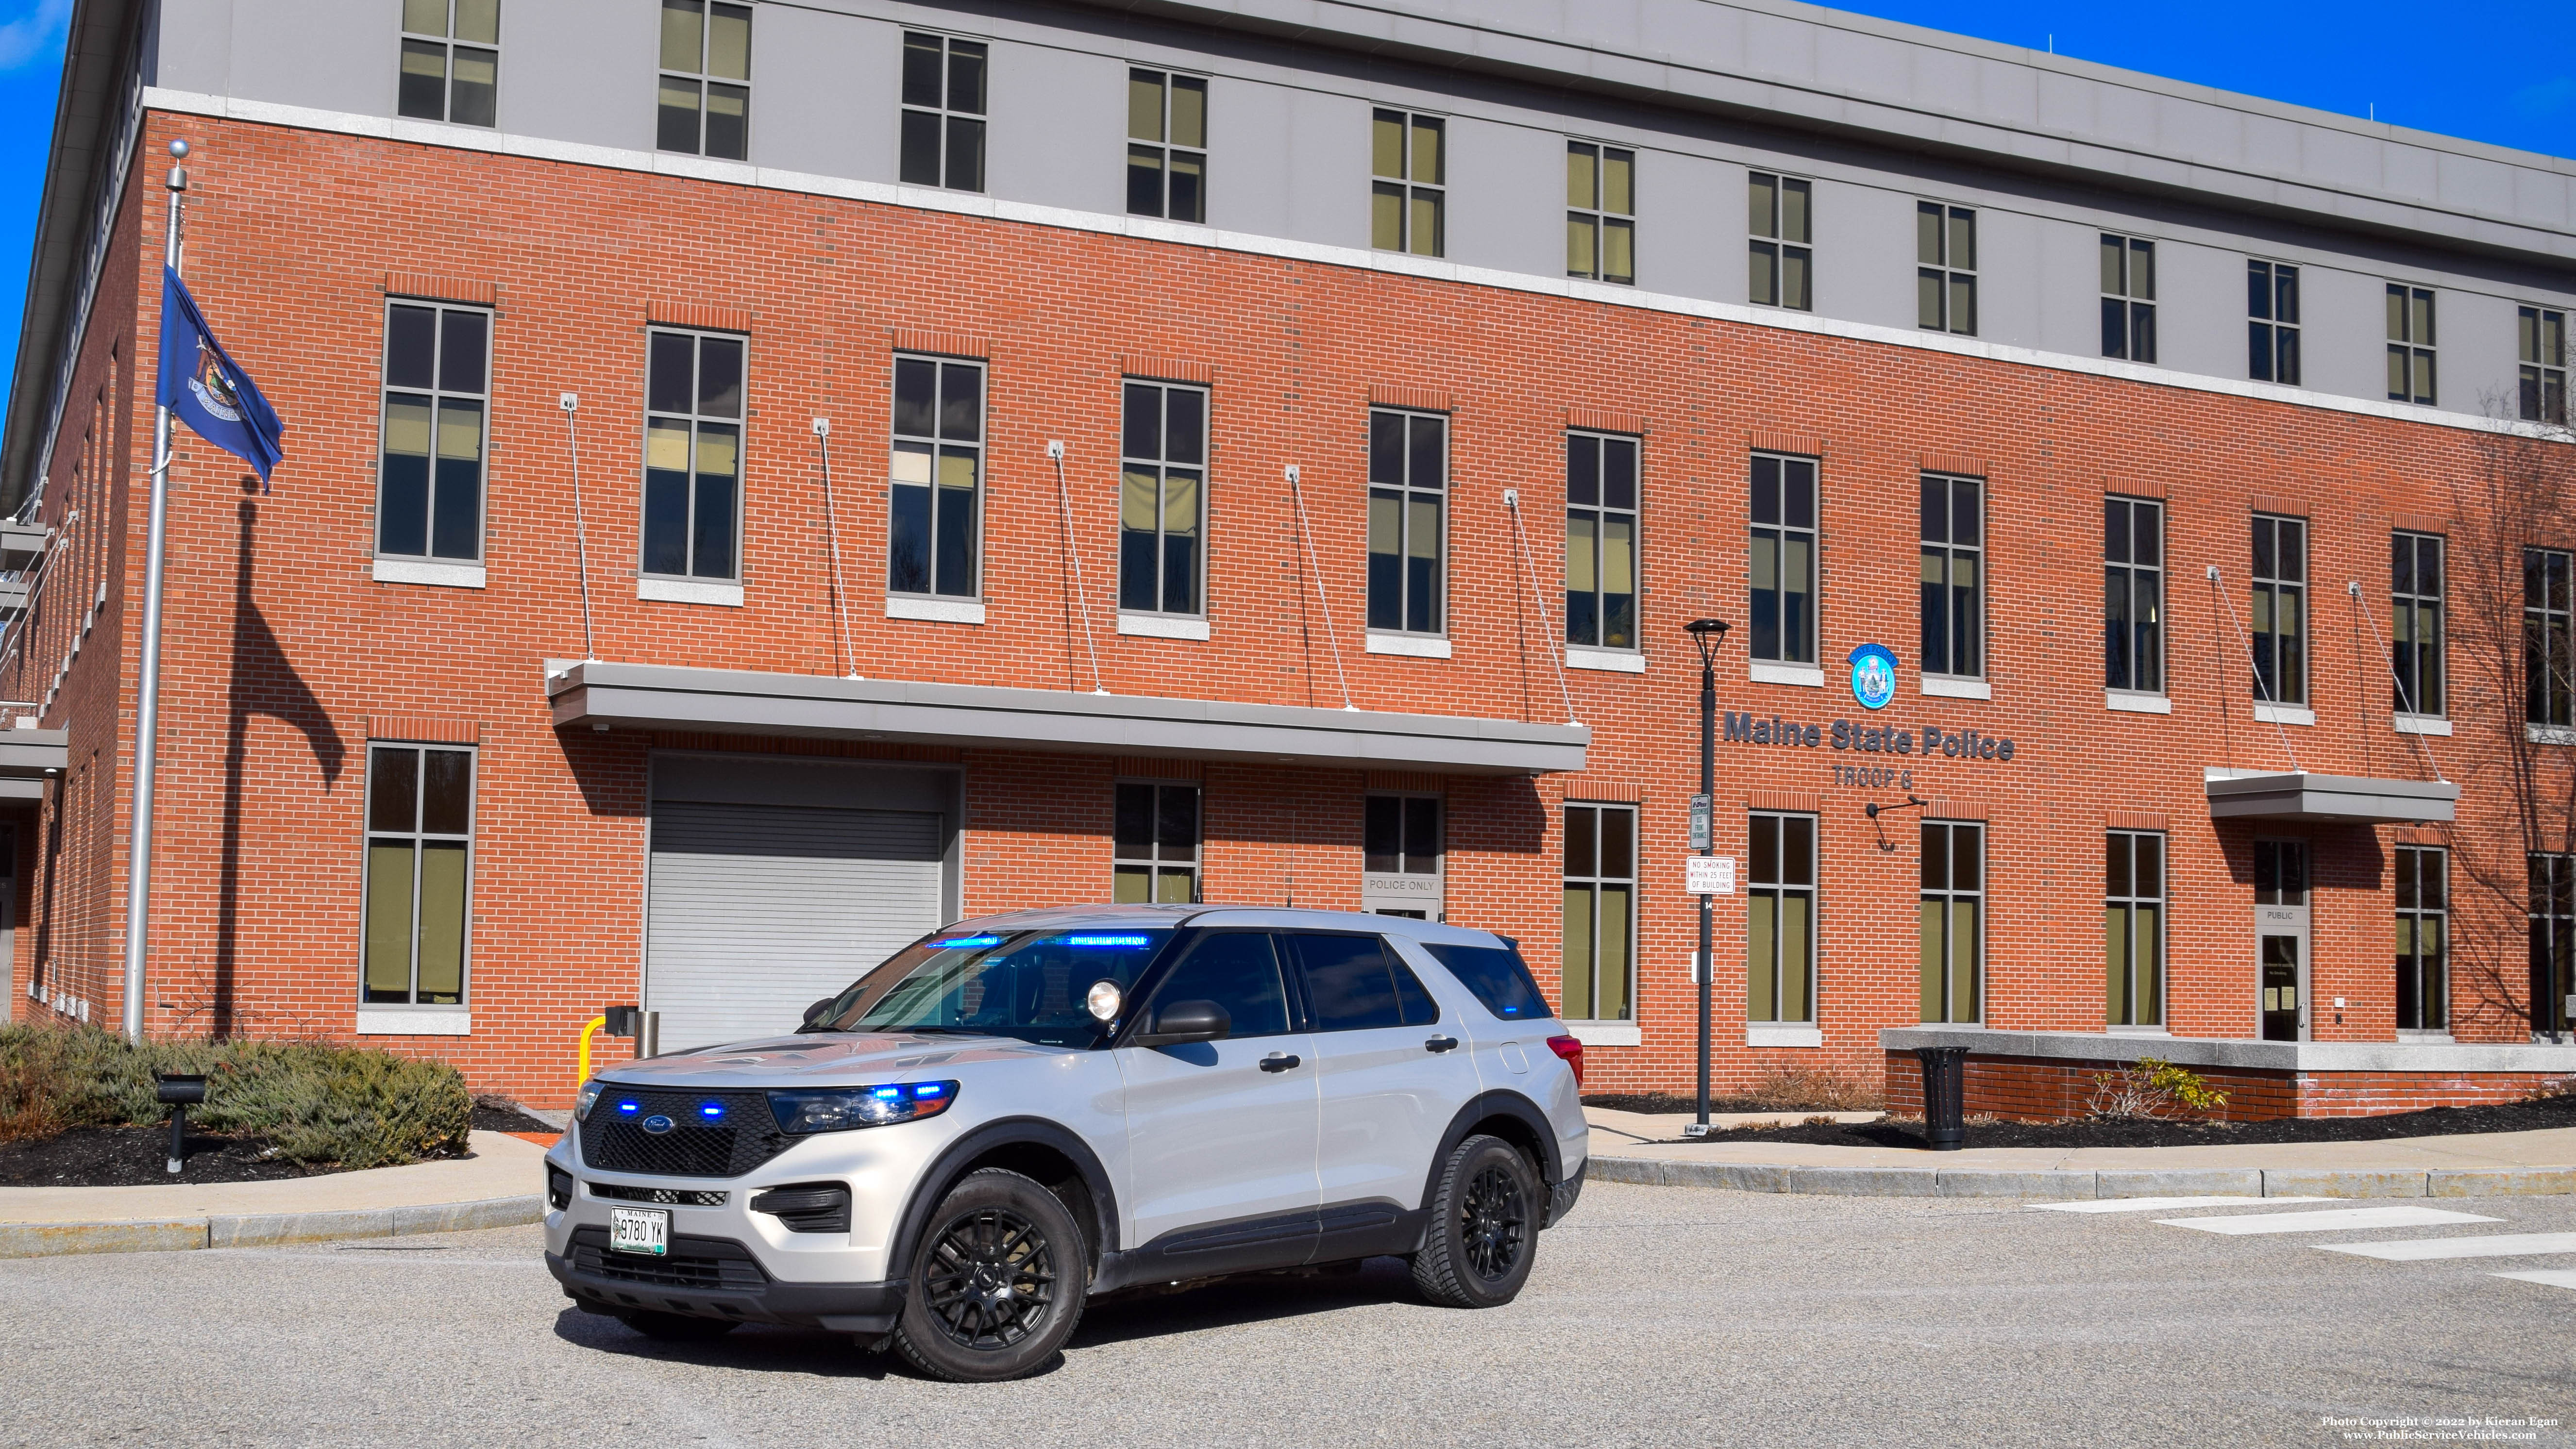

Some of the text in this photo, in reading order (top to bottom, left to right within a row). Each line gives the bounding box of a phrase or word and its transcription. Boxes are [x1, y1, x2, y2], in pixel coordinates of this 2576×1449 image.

[202, 395, 237, 419] MAINE
[1850, 646, 1897, 666] STATE POLICE
[1724, 711, 2014, 760] Maine State Police
[1832, 765, 1912, 789] TROOP G
[1369, 880, 1434, 890] POLICE ONLY
[2268, 911, 2293, 919] PUBLIC
[621, 1219, 663, 1243] 9780 YK
